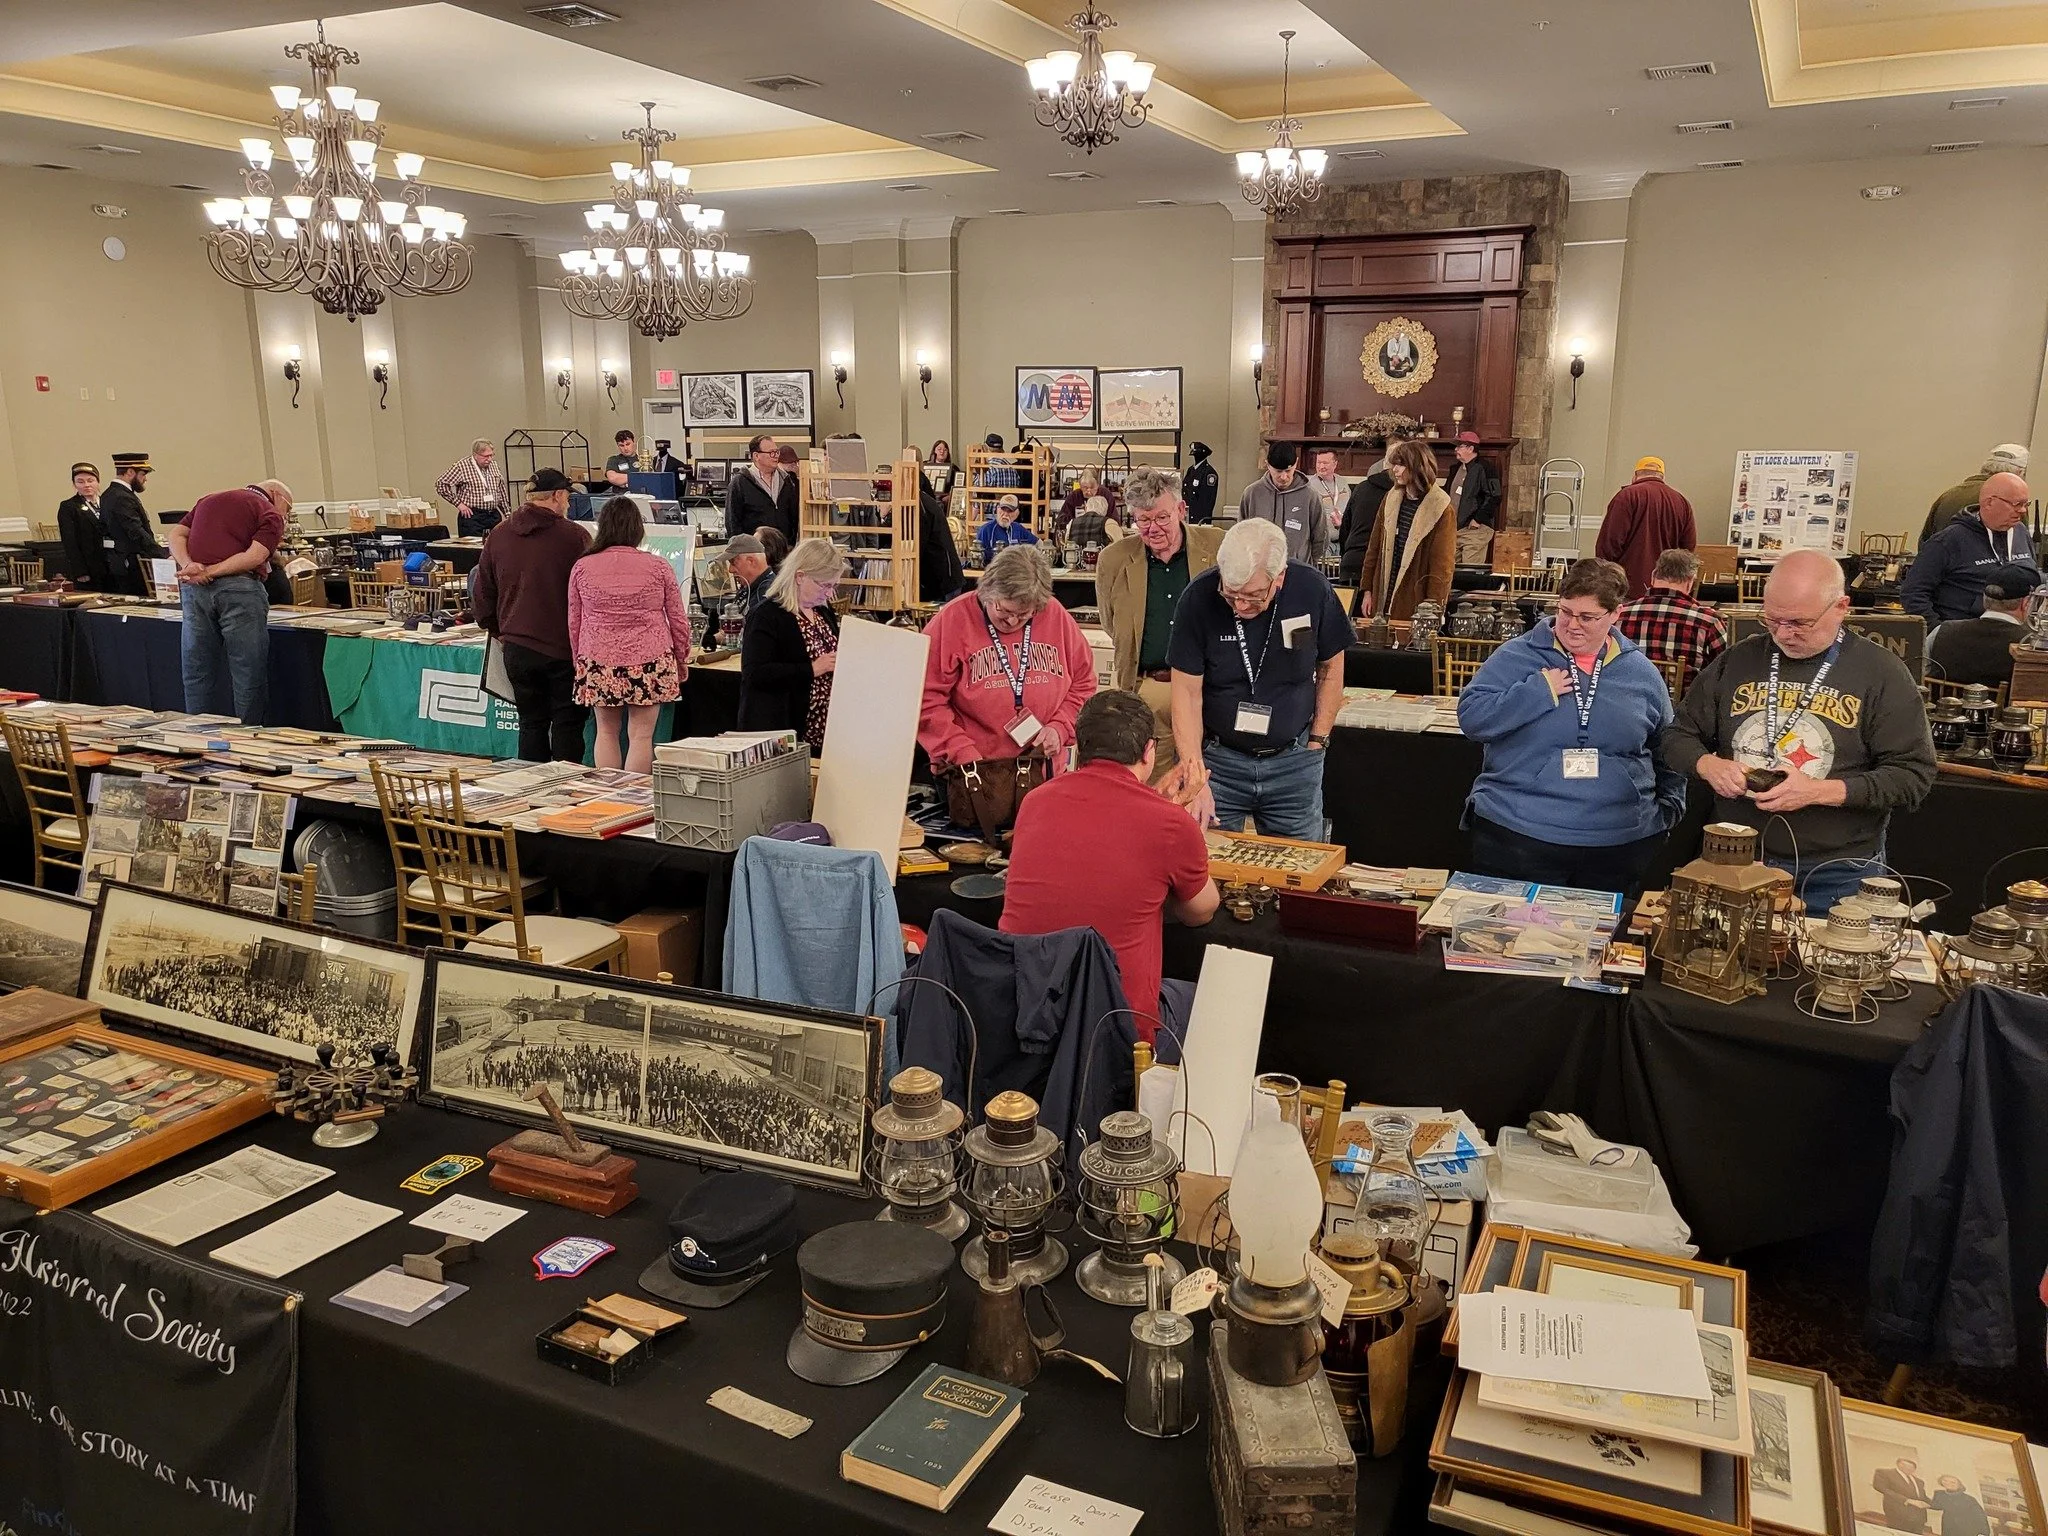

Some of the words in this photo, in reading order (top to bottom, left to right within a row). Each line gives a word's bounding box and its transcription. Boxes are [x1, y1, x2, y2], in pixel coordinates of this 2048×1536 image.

[1104, 420, 1115, 428] WE
[1117, 420, 1138, 428] SERVE
[1139, 420, 1155, 428] WITH
[1157, 419, 1176, 427] PRIDE
[1765, 456, 1782, 466] LOCK
[1790, 456, 1822, 466] LANTERN
[1023, 625, 1032, 657] LANTERN
[1236, 621, 1246, 641] LOCK
[1242, 649, 1254, 684] LANTERN
[987, 624, 998, 639] KEY
[994, 639, 1004, 656] LOCK
[1004, 664, 1017, 691] LANTER
[1772, 652, 1780, 670] KEY
[1570, 665, 1580, 687] LOCK
[1757, 681, 1840, 697] PITSBUGH
[1769, 671, 1778, 698] LOCK
[1581, 709, 1590, 726] KEY
[1592, 659, 1603, 689] LANTERN
[1730, 681, 1861, 729] STELERS
[1785, 709, 1803, 730] LOCK
[1804, 662, 1832, 699] LANTERN
[495, 710, 519, 720] HIST
[496, 721, 520, 731] SOC
[1767, 705, 1777, 743] LANTERN
[446, 1156, 480, 1171] POLICE
[123, 1287, 237, 1376] Society
[816, 1320, 848, 1338] AGENT
[933, 1389, 989, 1412] PROGRESS
[952, 1383, 996, 1403] CENTURY
[80, 1431, 149, 1471] STORY
[154, 1461, 176, 1486] AT
[185, 1475, 202, 1494] A
[1023, 1498, 1052, 1515] Touch
[1069, 1514, 1085, 1527] The
[1030, 1483, 1071, 1505] Please
[1085, 1504, 1120, 1520] Don't
